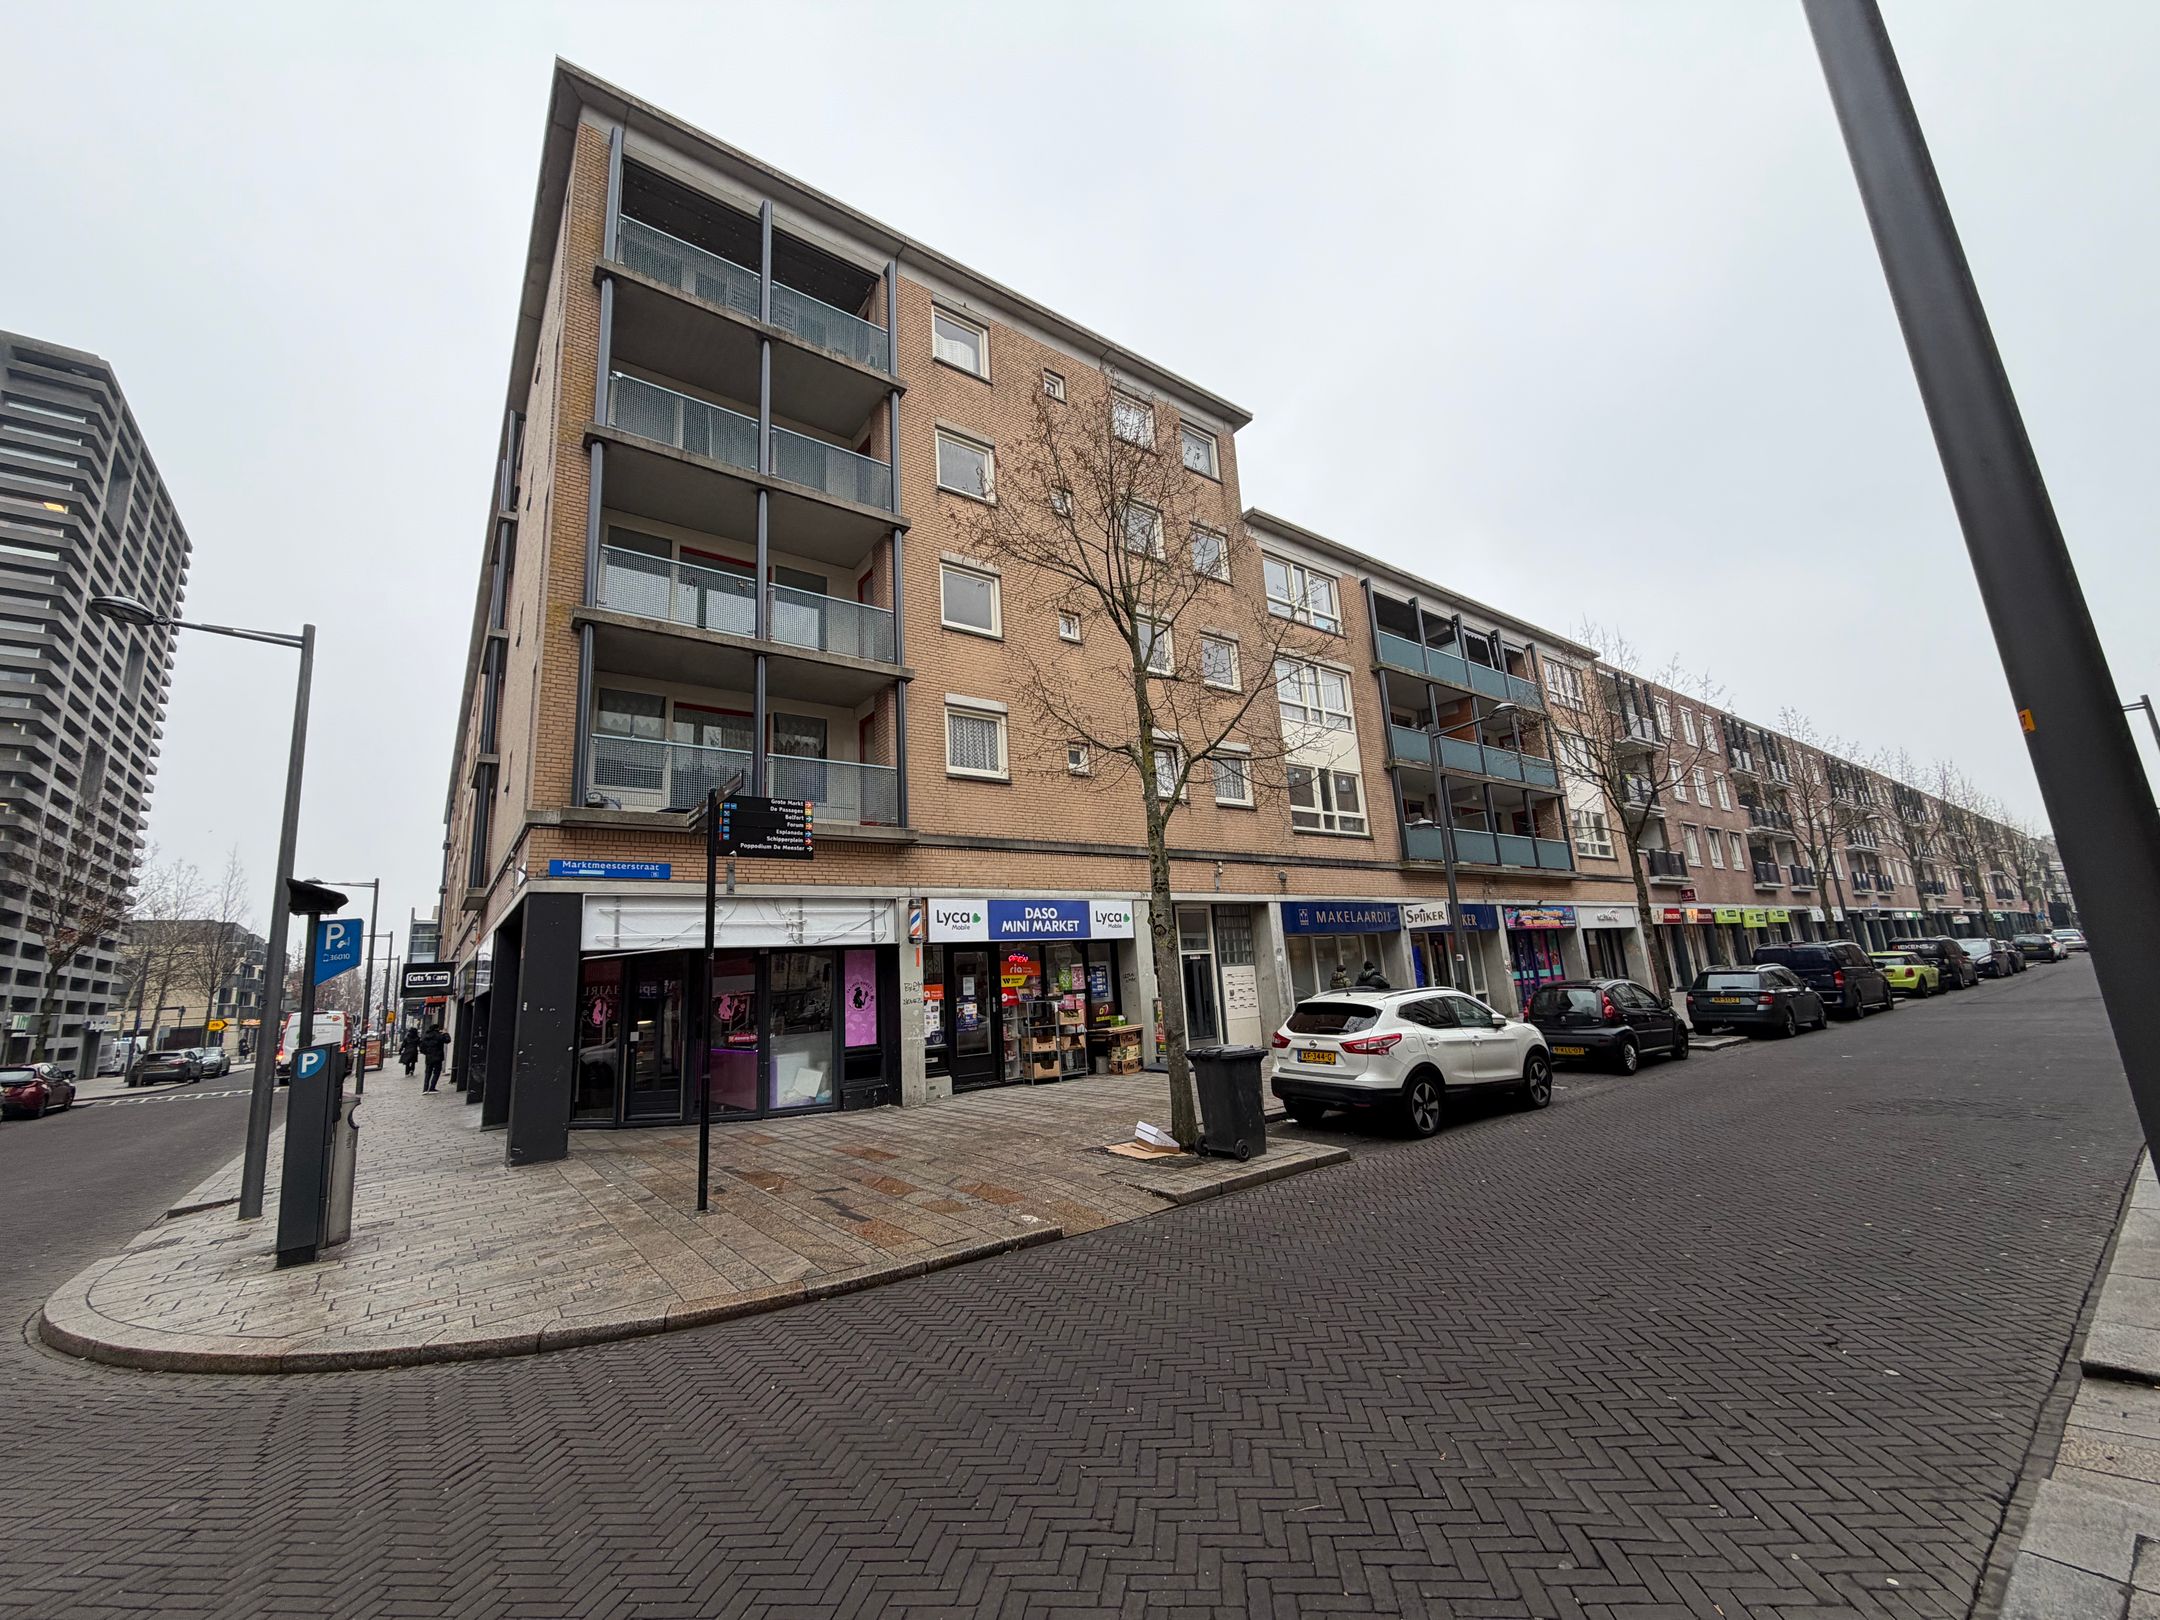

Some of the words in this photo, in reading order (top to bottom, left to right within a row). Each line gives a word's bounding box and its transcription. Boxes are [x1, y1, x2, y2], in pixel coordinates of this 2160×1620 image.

[562, 860, 660, 871] Marktmeesterstraat
[936, 909, 970, 926] Lyca
[1024, 907, 1058, 919] DASO
[1095, 910, 1122, 925] Lyca
[1316, 911, 1391, 924] MAKELAARDIJ
[1406, 908, 1445, 924] SPIJKER
[1001, 921, 1030, 933] MINI
[1031, 920, 1080, 932] MARKET
[325, 923, 345, 950] P
[329, 953, 351, 961] 36010
[1008, 954, 1029, 963] OPEN
[1010, 963, 1023, 973] ria
[409, 974, 424, 982] Cuts
[301, 1052, 319, 1073] P
[1303, 1052, 1332, 1061] XF-344-G
